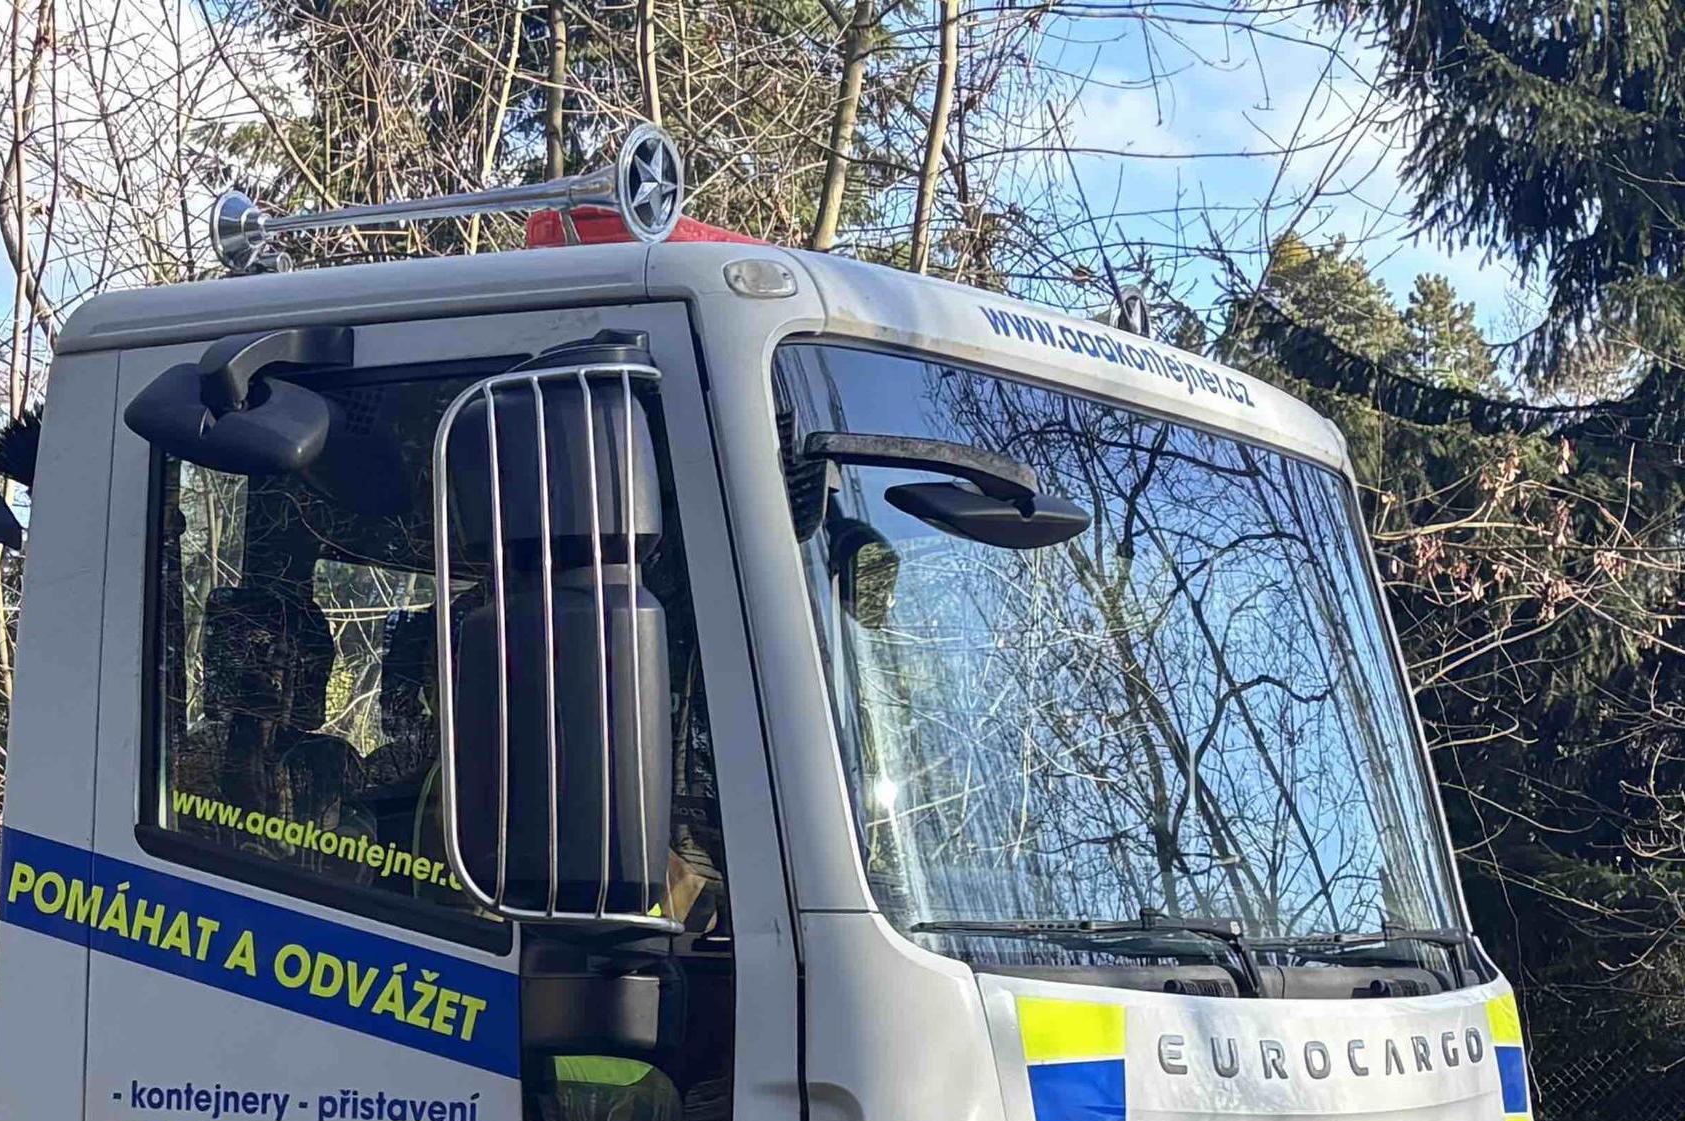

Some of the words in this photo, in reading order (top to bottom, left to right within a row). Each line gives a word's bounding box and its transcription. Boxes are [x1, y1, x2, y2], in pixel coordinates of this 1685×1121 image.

[980, 306, 1255, 408] www.aaakontejner.cz
[8, 861, 219, 961] POMÁHAT
[224, 931, 257, 976] A
[274, 944, 487, 1041] ODVÁŽET
[1158, 1027, 1484, 1080] EUROCARGO
[130, 1080, 290, 1121] kontejnery
